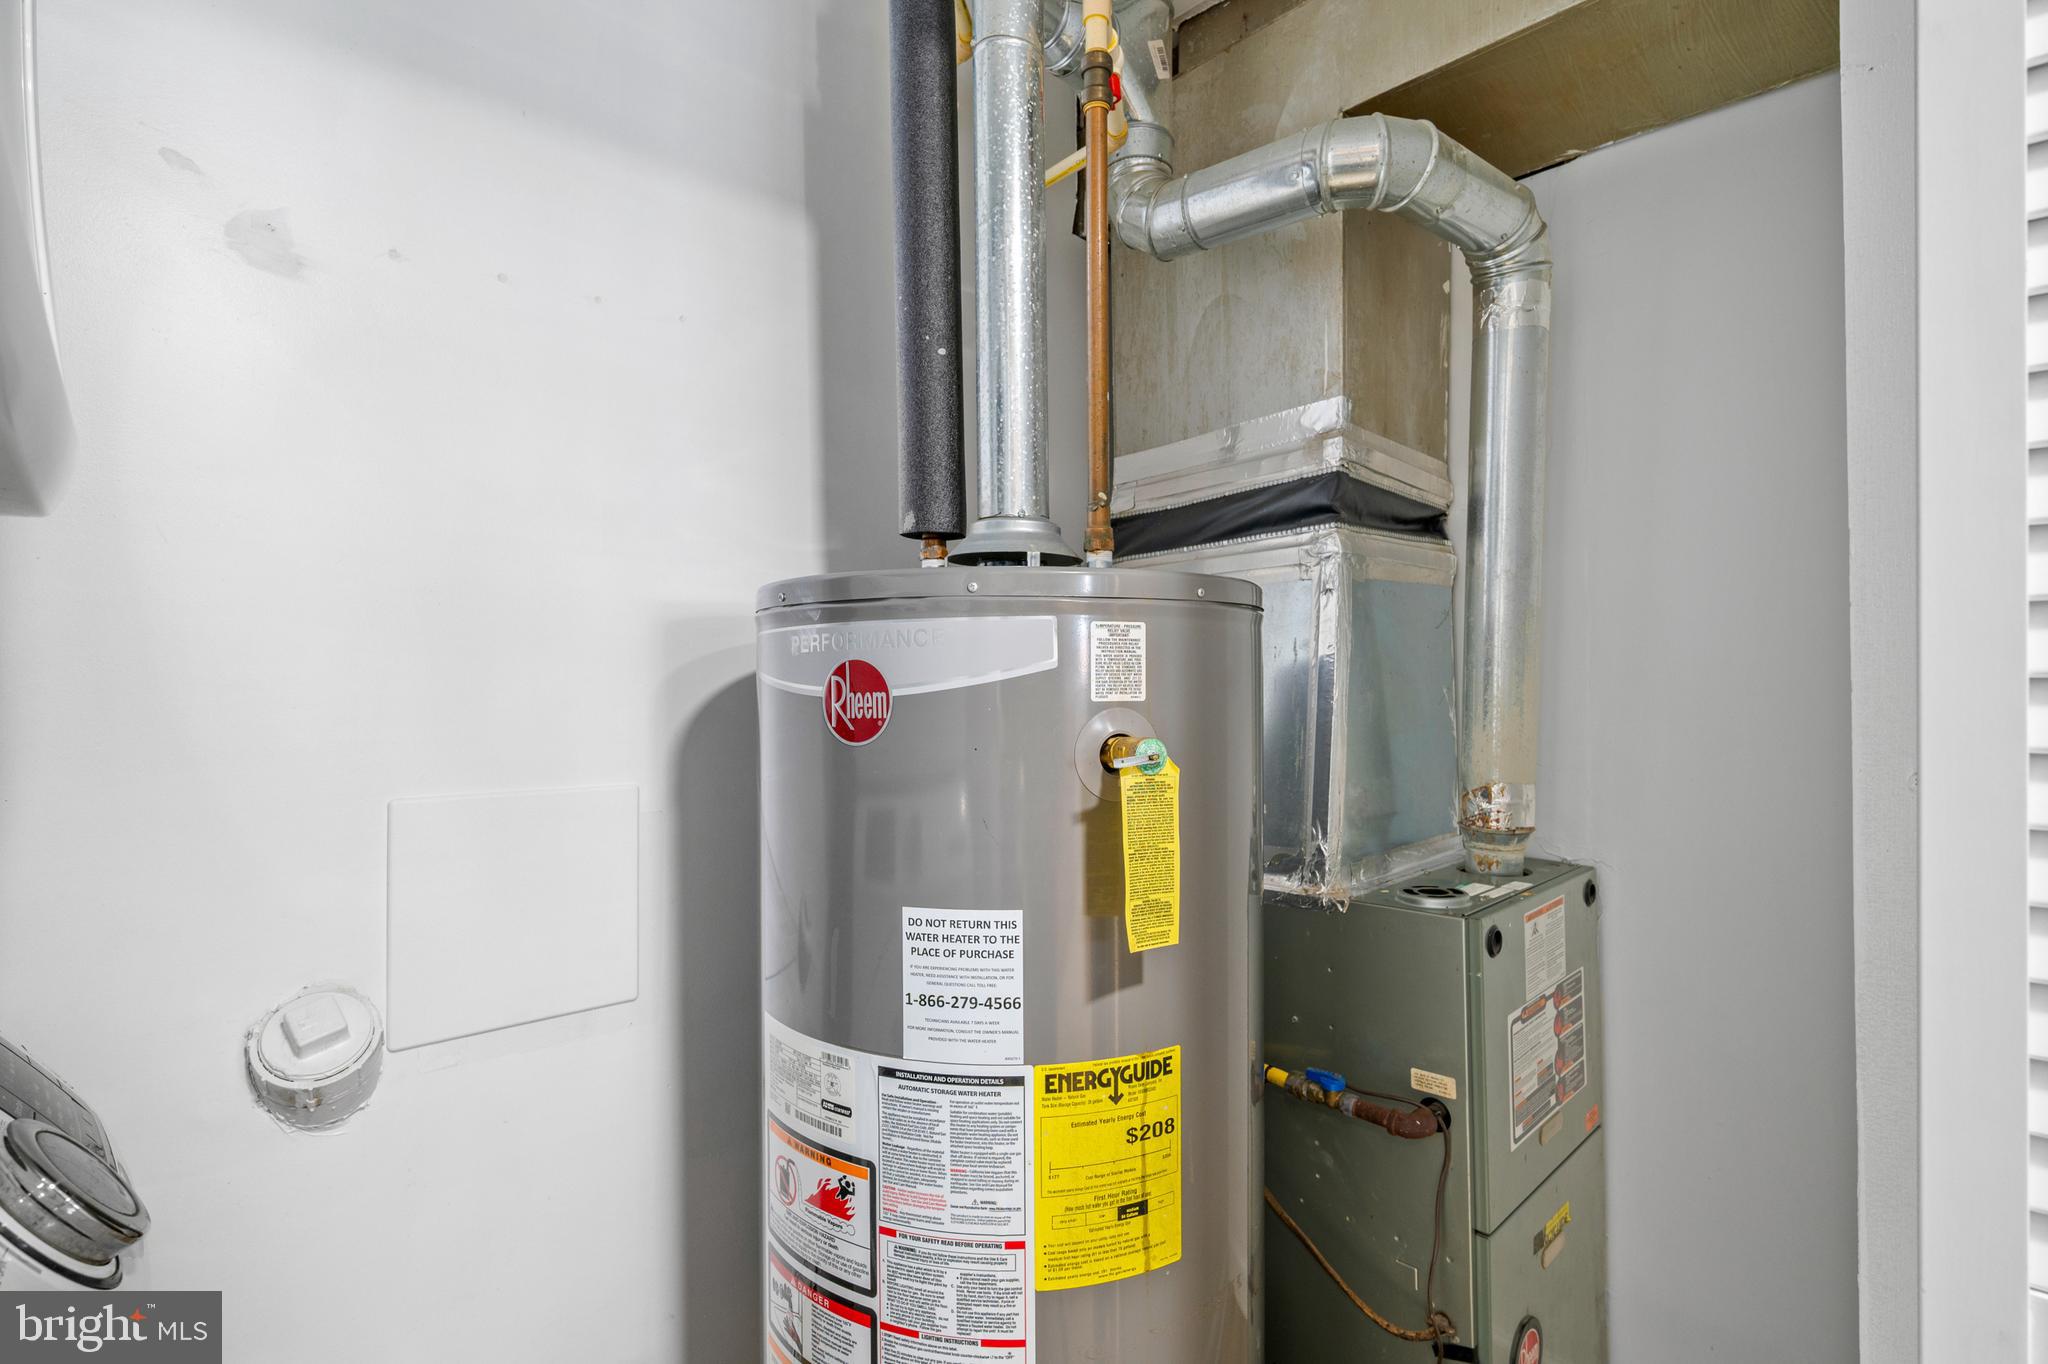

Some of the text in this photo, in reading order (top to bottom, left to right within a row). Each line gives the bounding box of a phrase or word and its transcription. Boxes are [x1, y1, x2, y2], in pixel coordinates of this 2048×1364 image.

[791, 627, 945, 653] PERFORMANCE
[831, 661, 887, 730] Rheem
[908, 918, 1017, 929] DO NOT RETURN THIS
[906, 932, 1020, 944] WATER HEATER TO THE
[911, 947, 1014, 959] PLACE OF PURCHASE
[906, 993, 1021, 1010] 1-866-279-4566
[896, 1071, 933, 1082] INSTALLATION
[1045, 1056, 1173, 1095] ENERGYGUIDE
[898, 1084, 930, 1094] AUTOMATIC
[1071, 1110, 1146, 1127] Estimated Yearly Energy Cost
[1126, 1118, 1174, 1146] $208
[795, 1142, 832, 1166] WARNING
[1108, 1191, 1120, 1199] Hour
[1122, 1189, 1137, 1197] Rating
[805, 1207, 843, 1229] Flammable Vapors
[922, 1237, 939, 1245] SAFETY
[798, 1282, 829, 1309] DANGER
[922, 1334, 978, 1346] LIGHTING INSTRUCTIONS
